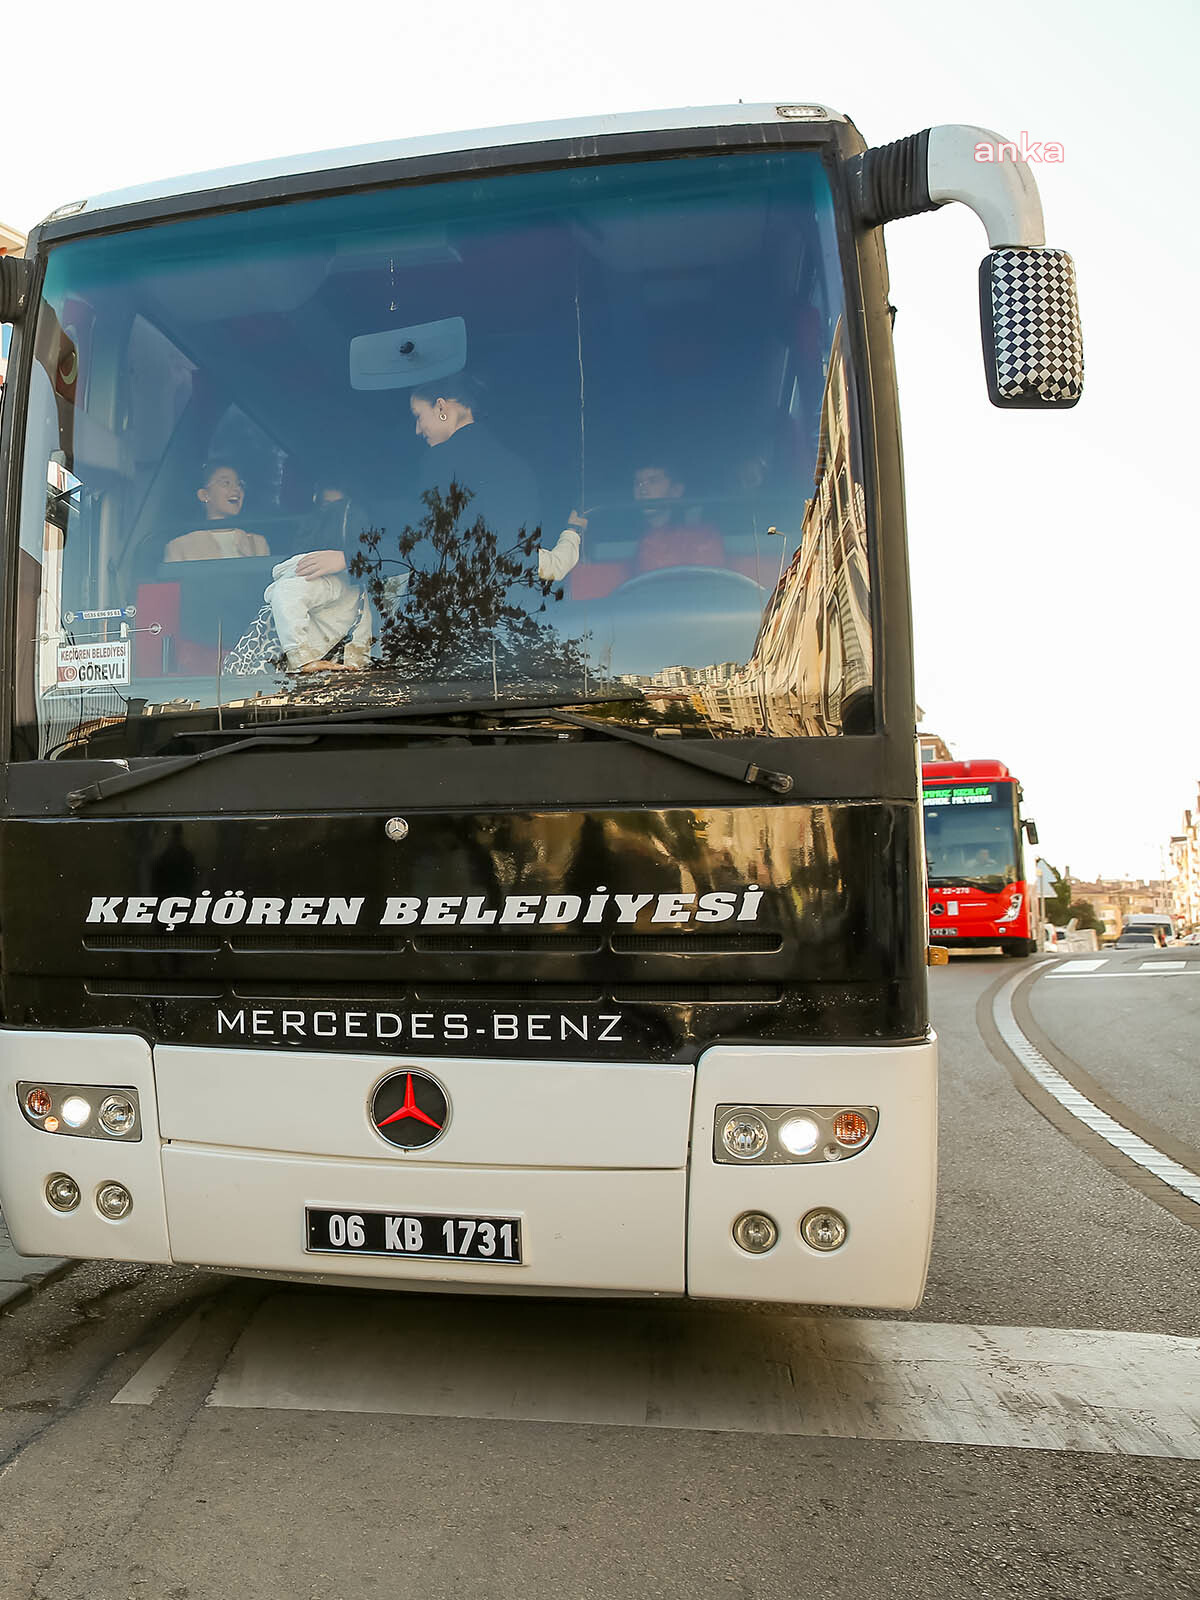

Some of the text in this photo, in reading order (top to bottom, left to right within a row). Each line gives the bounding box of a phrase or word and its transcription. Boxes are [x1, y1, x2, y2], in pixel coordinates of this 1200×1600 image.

[61, 644, 126, 662] KEÇİÖREN BELEDİYESİ
[79, 659, 125, 681] GÖREVLİ
[85, 884, 764, 931] KEÇİÖREN BELEDİYESİ
[217, 1010, 623, 1041] MERCEDES-BENZ
[328, 1214, 513, 1258] 06 KB 1731
